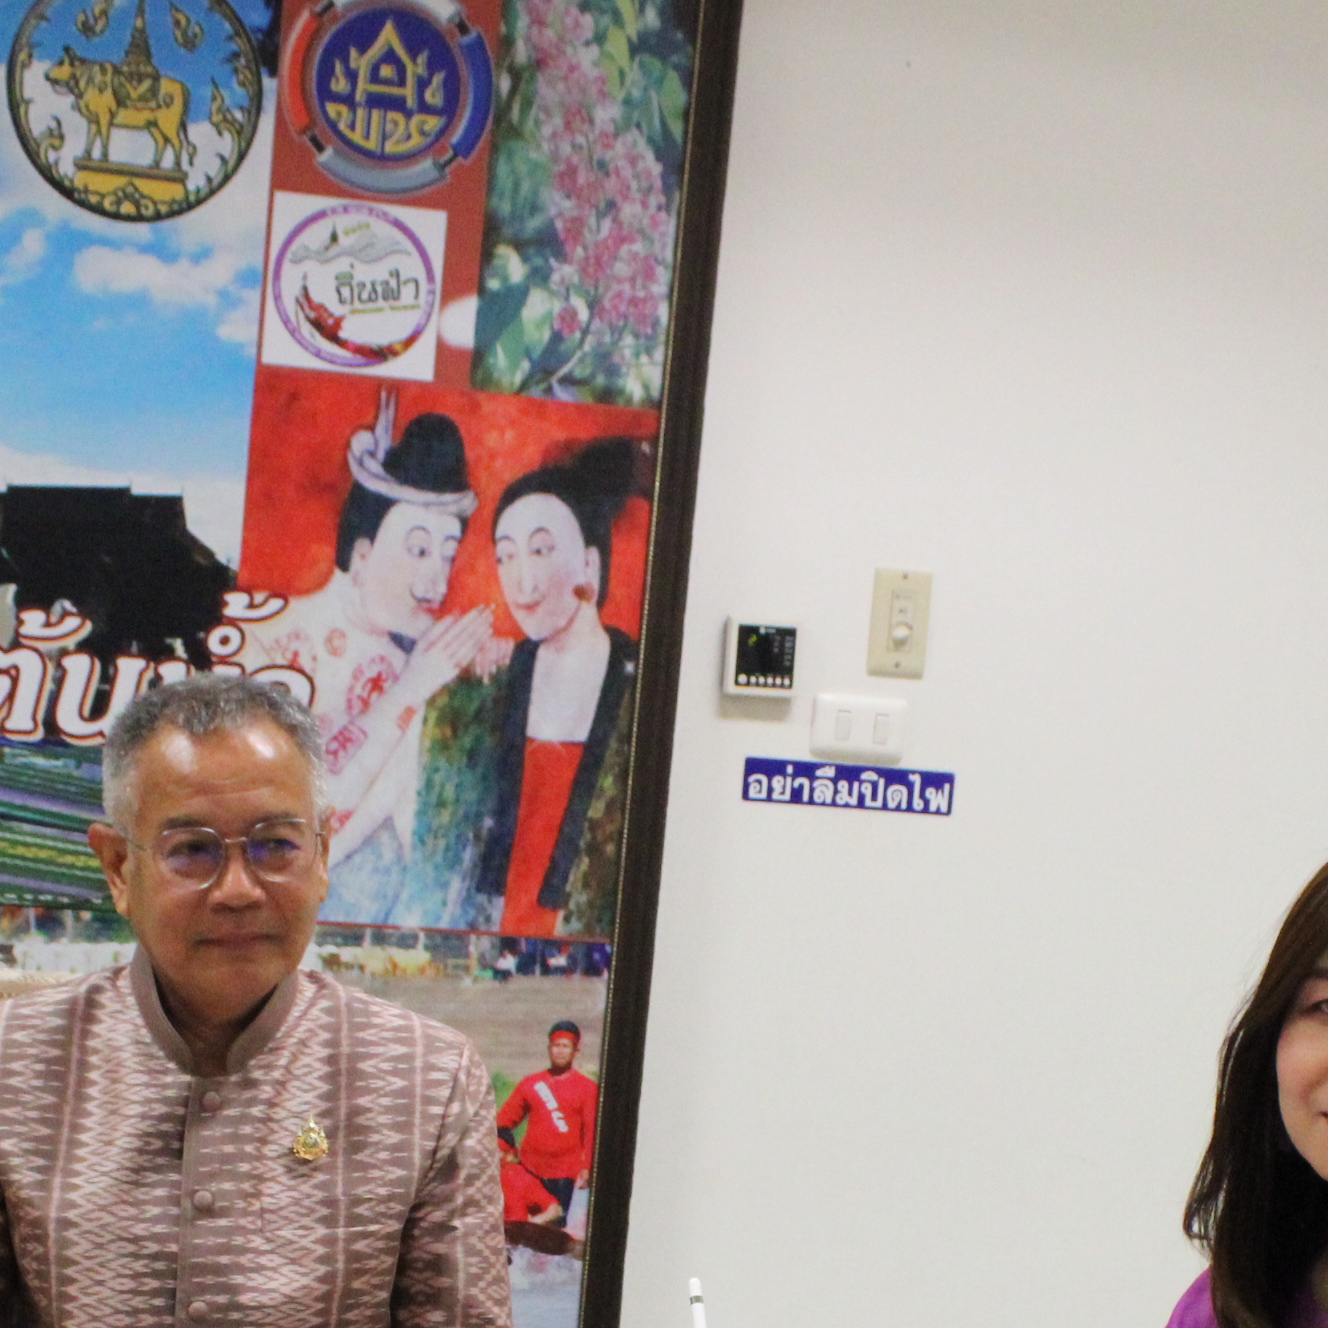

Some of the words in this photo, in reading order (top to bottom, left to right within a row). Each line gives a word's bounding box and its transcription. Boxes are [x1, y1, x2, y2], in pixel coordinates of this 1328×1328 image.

[746, 764, 951, 814] อย่าลืมปิดไฟ
